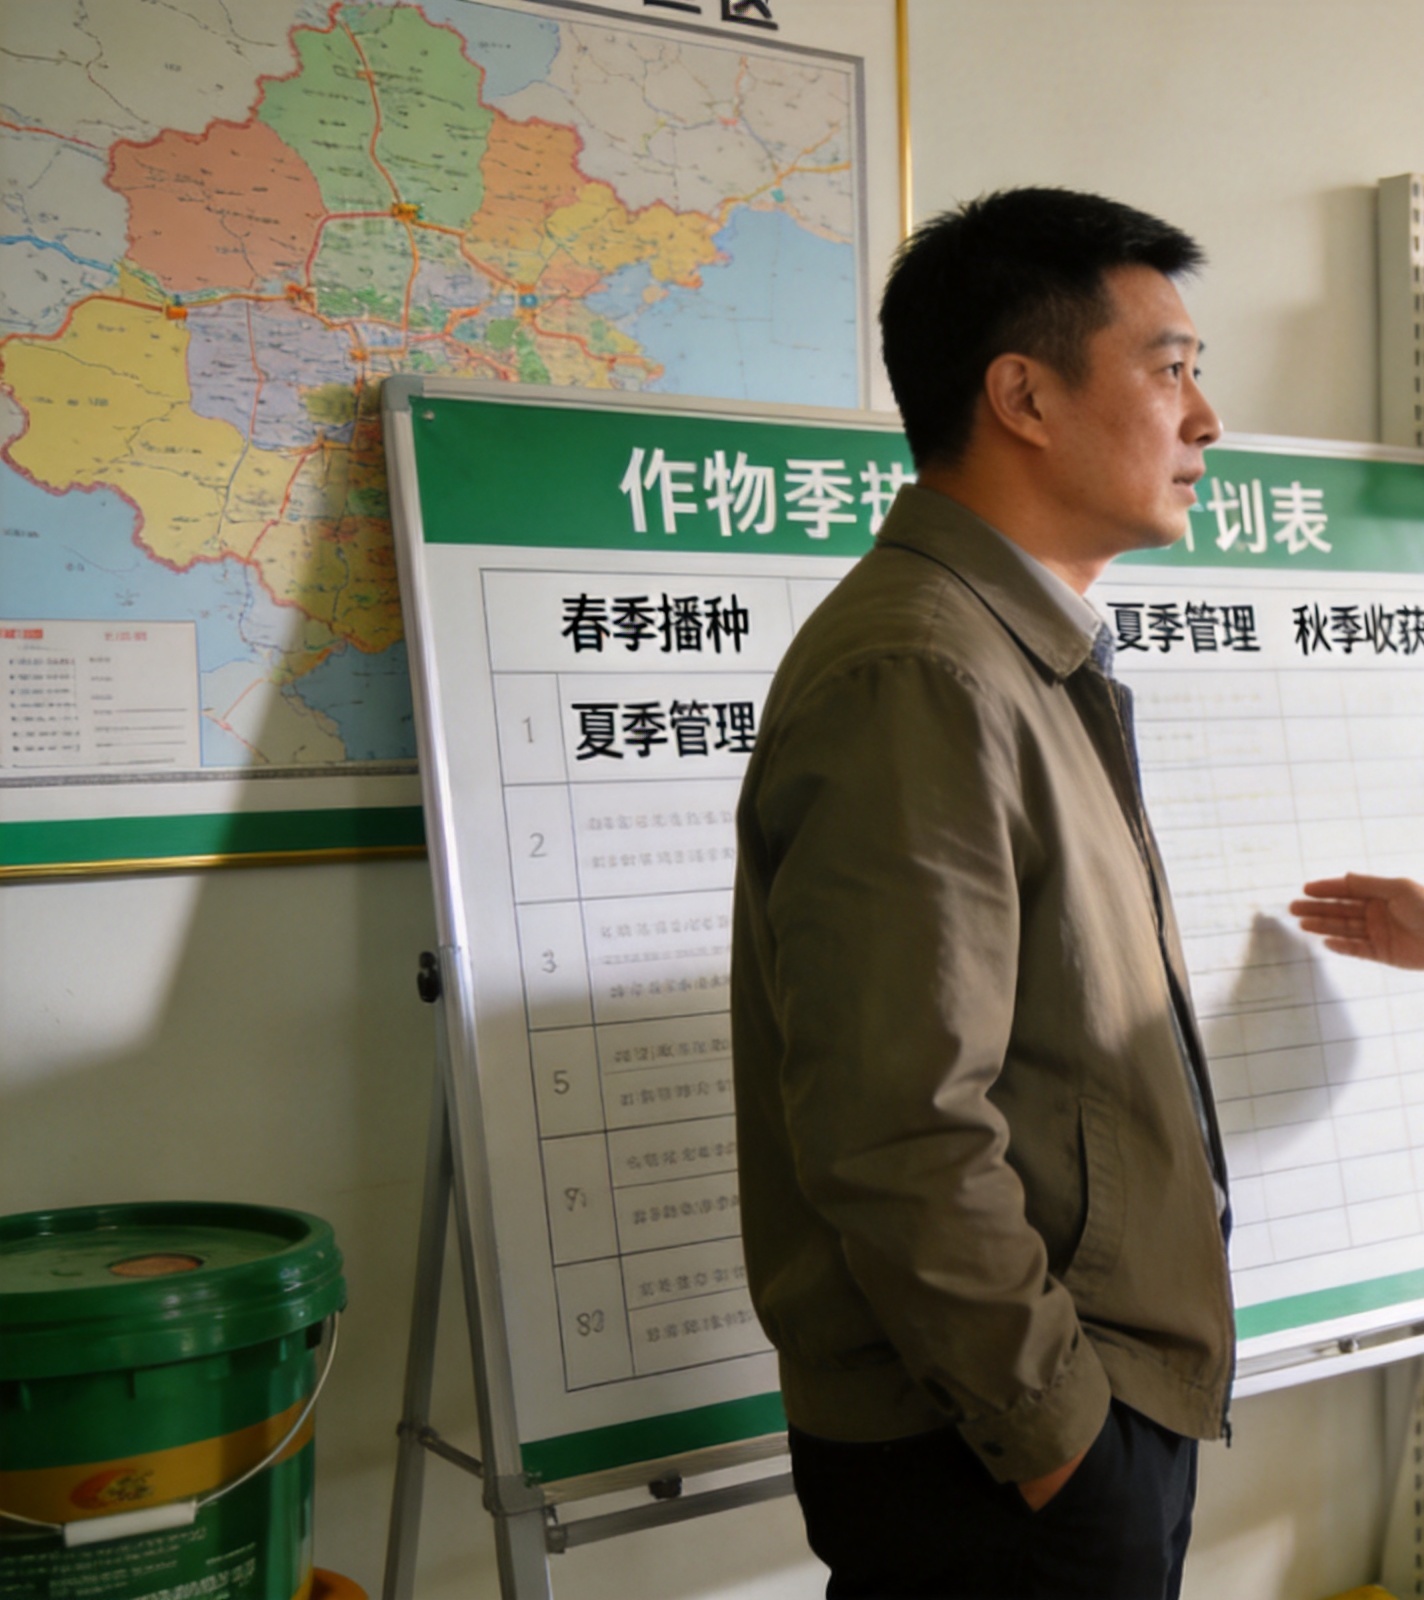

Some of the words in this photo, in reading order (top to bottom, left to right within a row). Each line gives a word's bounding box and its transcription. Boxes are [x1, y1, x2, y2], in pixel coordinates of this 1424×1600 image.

[562, 593, 749, 653] 春季播种
[1107, 601, 1260, 653] 夏季管理
[521, 717, 535, 744] 1
[571, 699, 756, 760] 夏季管理
[529, 833, 548, 858] 2
[541, 949, 557, 974] 3
[553, 1070, 570, 1095] 5
